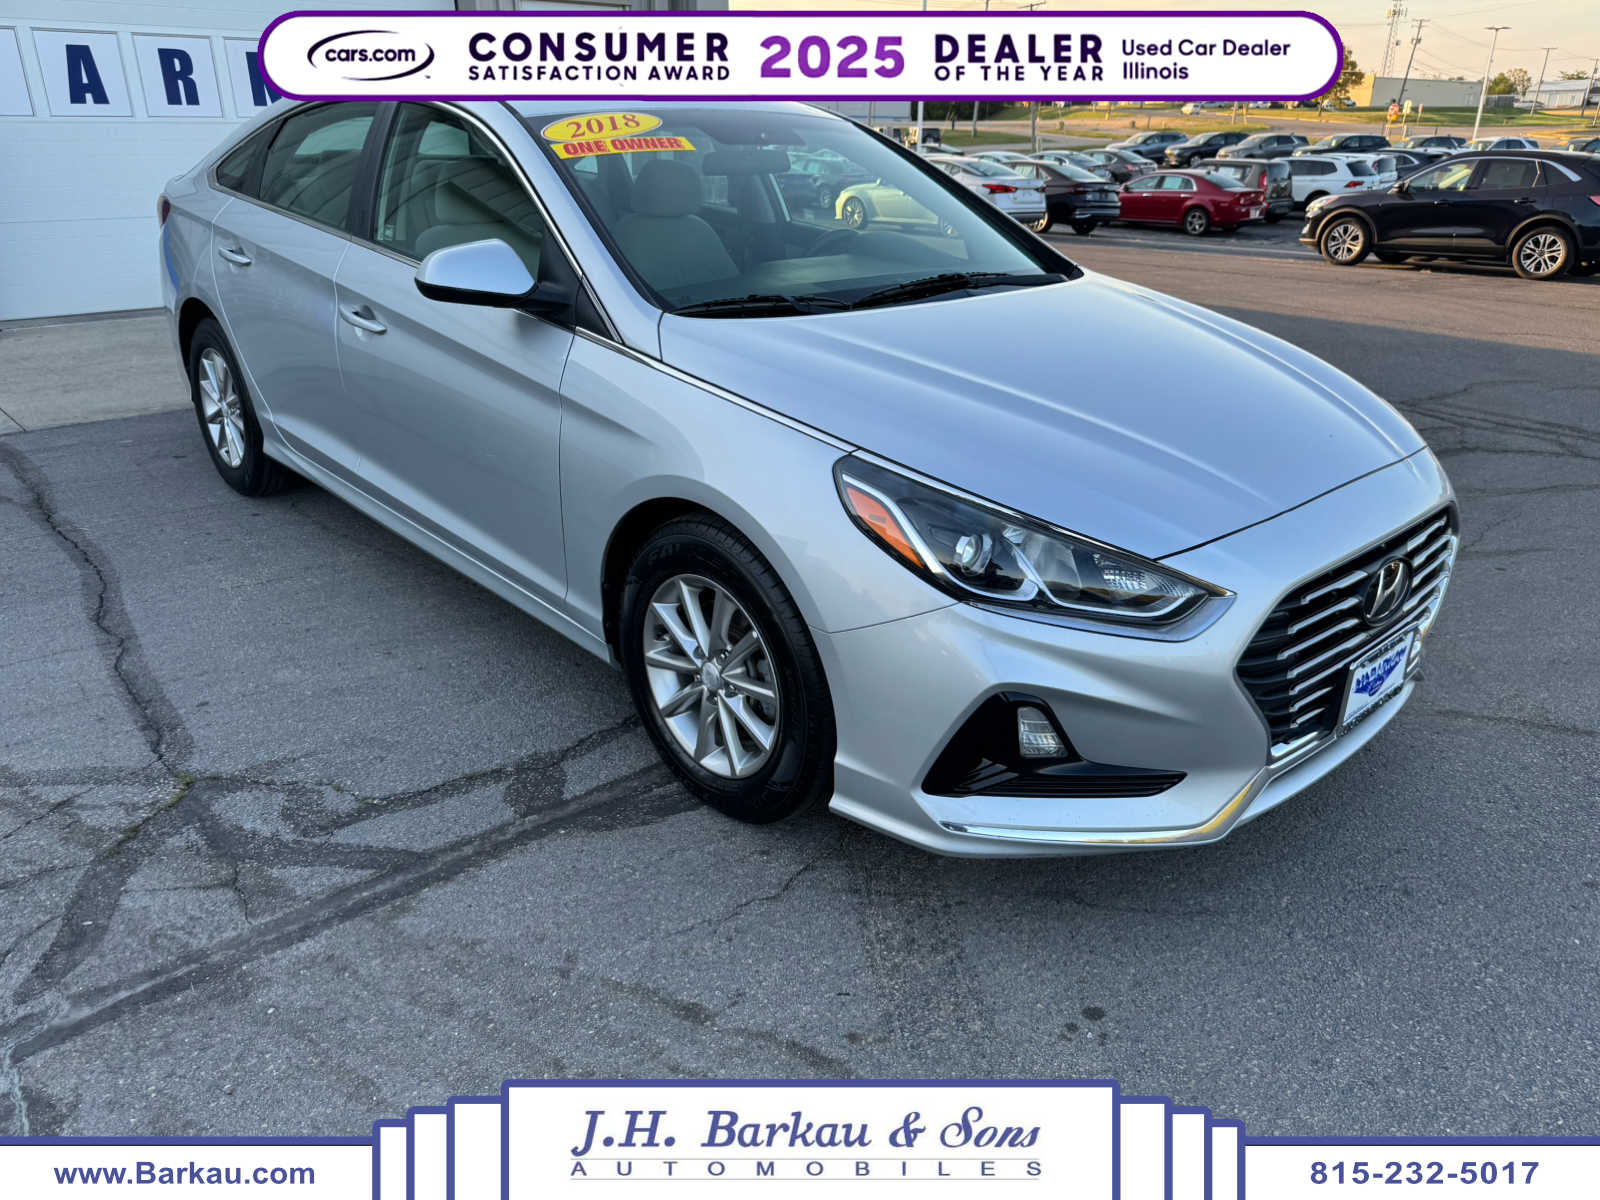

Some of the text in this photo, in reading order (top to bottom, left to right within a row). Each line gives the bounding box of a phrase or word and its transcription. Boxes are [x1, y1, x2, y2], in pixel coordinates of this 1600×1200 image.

[566, 114, 641, 139] 2018
[563, 137, 684, 156] ONE OWNER
